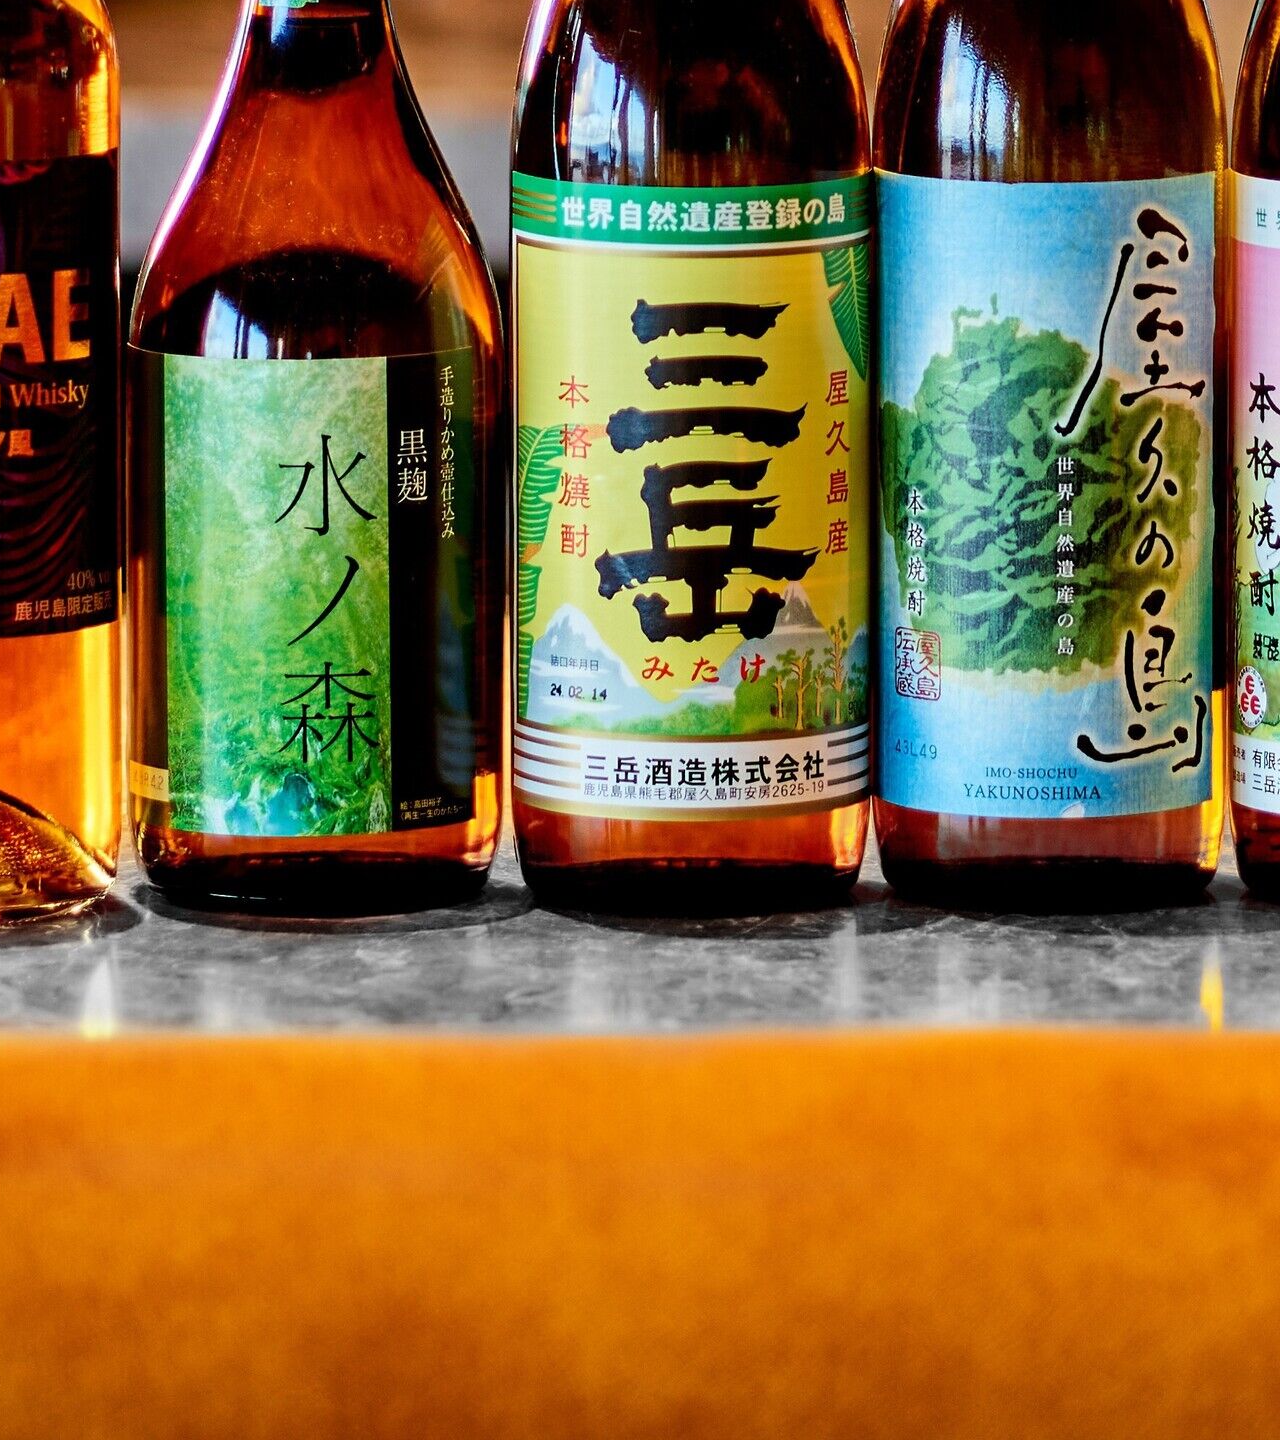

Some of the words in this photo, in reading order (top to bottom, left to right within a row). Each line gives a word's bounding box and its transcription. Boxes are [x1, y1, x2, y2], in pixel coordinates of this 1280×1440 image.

[561, 192, 846, 232] 世界自然遺産登録の島
[9, 378, 89, 408] Whisky
[594, 297, 821, 643] 三岳
[824, 369, 851, 555] 屋久島産
[906, 488, 926, 617] 本格焼酎
[1056, 456, 1075, 656] 世界自然遺産の島
[274, 434, 380, 763] 水ノ森
[641, 654, 766, 684] みたけ
[585, 749, 825, 786] 三岳酒造株式会社
[985, 766, 1078, 780] IMO-SHOCHU
[963, 784, 1102, 801] YAKUNOSHIMA
